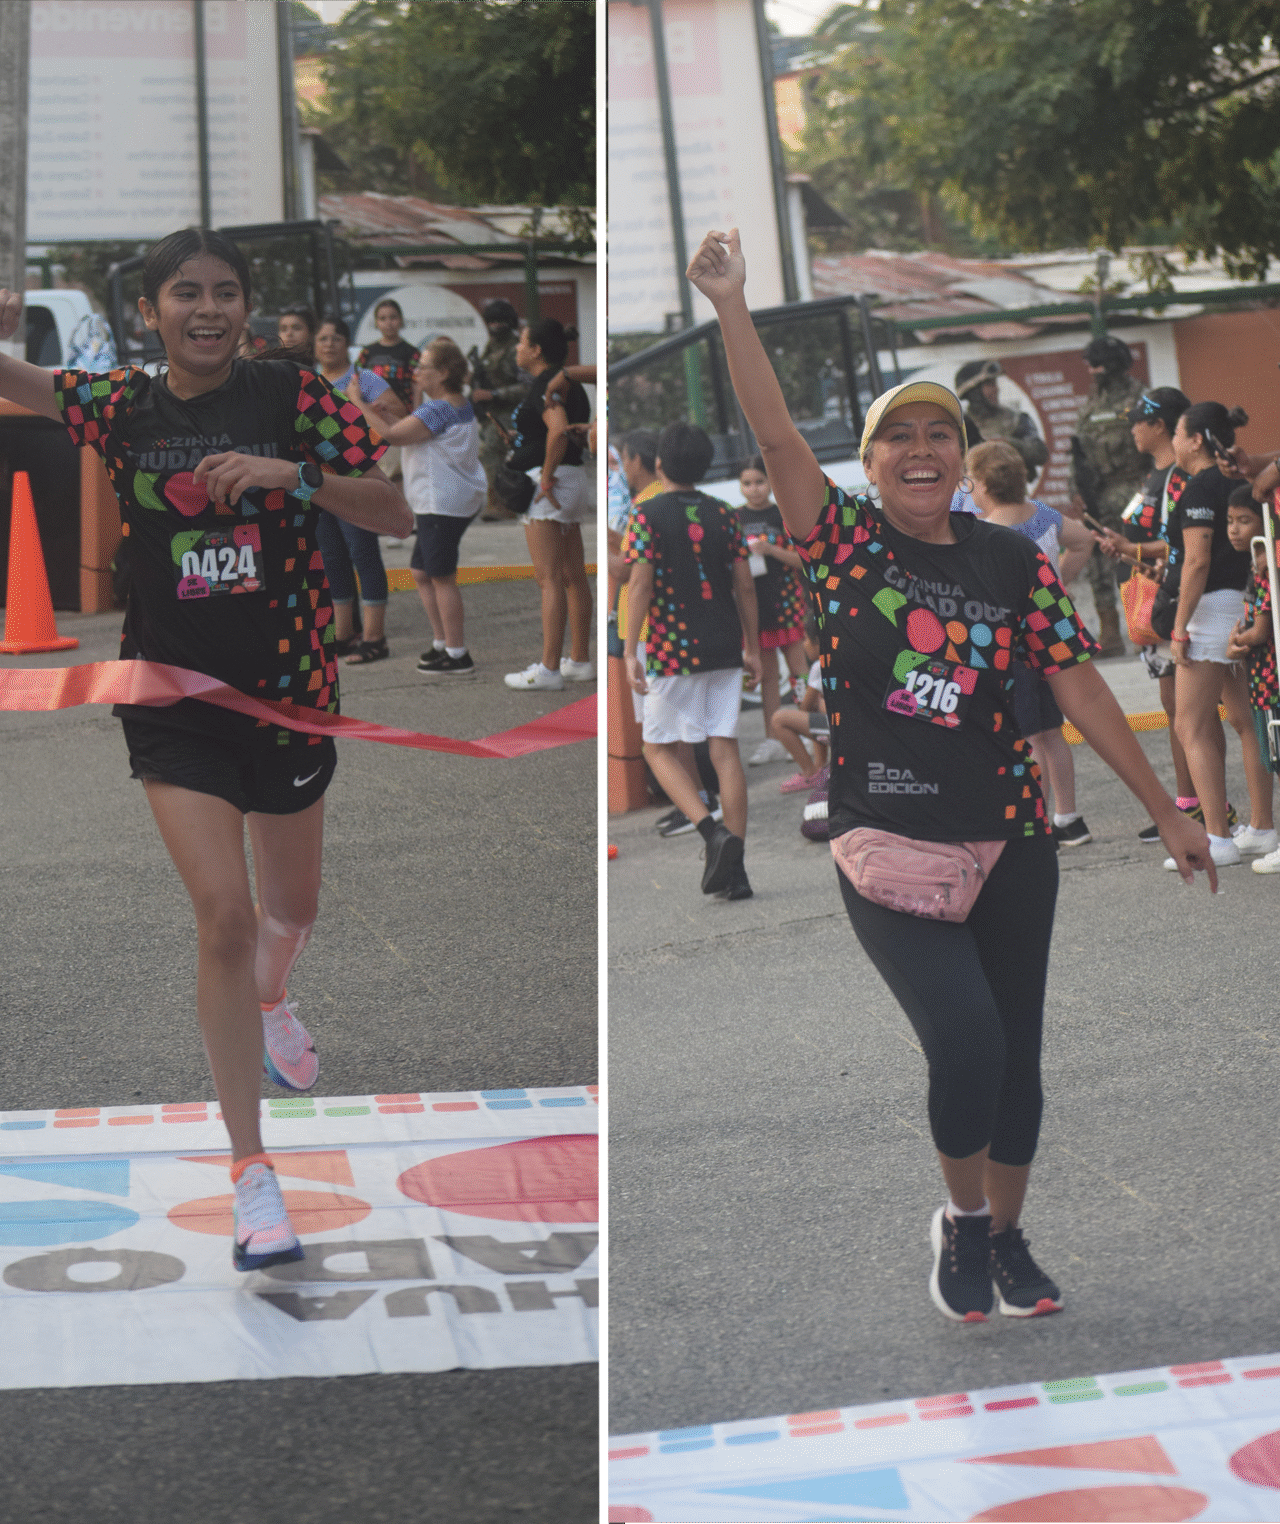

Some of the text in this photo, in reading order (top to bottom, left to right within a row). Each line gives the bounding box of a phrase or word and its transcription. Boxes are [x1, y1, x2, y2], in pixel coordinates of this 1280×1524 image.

[171, 433, 233, 448] ZIHUA
[180, 544, 257, 582] 0424
[905, 669, 962, 713] 1216
[868, 762, 915, 781] 2DA
[868, 780, 939, 795] EDICIÓN
